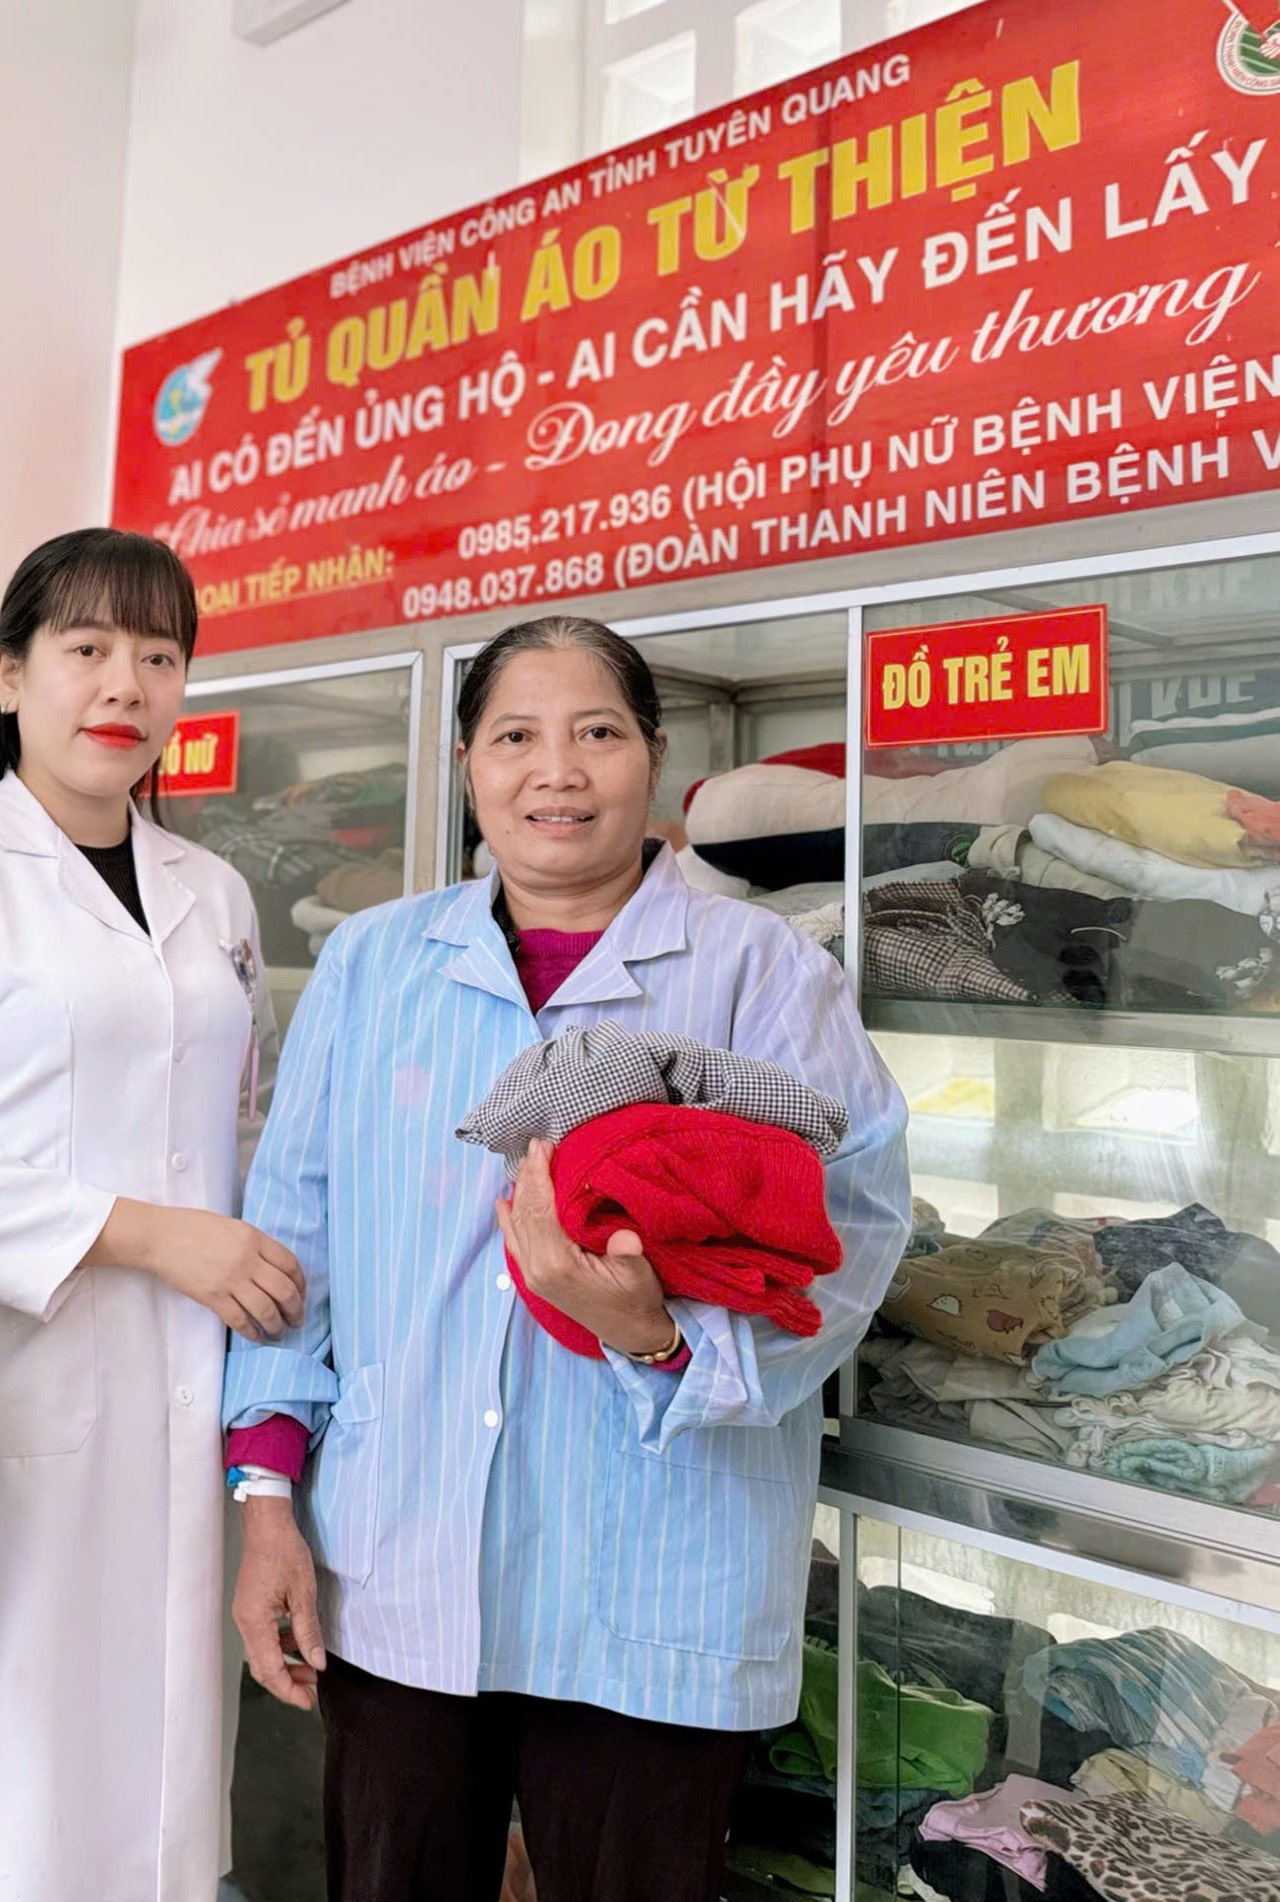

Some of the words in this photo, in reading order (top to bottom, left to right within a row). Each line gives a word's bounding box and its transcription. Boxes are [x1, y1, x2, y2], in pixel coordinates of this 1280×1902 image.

[244, 316, 311, 414] TỦ
[326, 260, 501, 388] QUẦN
[519, 225, 622, 322] ÁO
[646, 163, 761, 277] TỪ
[778, 59, 1082, 235] THIỆN
[329, 252, 395, 299] BỆNH
[398, 229, 456, 270] VIỆN
[460, 197, 536, 248] CÔNG
[542, 179, 582, 217] AN
[588, 149, 657, 198] TỈNH
[663, 106, 771, 170] TUYÊN
[781, 54, 911, 125] QUANG
[167, 460, 203, 506] AI
[208, 432, 261, 493] CÓ
[265, 405, 345, 477] ĐẾN
[354, 385, 445, 450] ỦNG
[458, 349, 527, 420] HỘ
[536, 370, 555, 386] -
[566, 331, 616, 389] AI
[631, 285, 748, 369] CẦN
[769, 247, 900, 333] HÃY
[920, 186, 1073, 290] ĐẾN
[1104, 129, 1268, 240] LẤY
[288, 454, 410, 531] manh
[414, 452, 476, 498] áo
[701, 354, 827, 440] đầy
[826, 330, 961, 427] yêu
[970, 262, 1263, 364] thương
[402, 551, 606, 619] 0948.037.868
[614, 522, 740, 586] (ĐOÀN
[751, 494, 907, 557] THANH
[925, 467, 1045, 529] NIÊN
[1066, 442, 1230, 506] BỆNH
[458, 483, 672, 560] 0985.217.936
[682, 456, 767, 523] (HỘI
[780, 440, 873, 496] PHỤ
[888, 414, 963, 474] NỮ
[972, 387, 1122, 458] BỆNH
[1142, 353, 1280, 421] VIỆN
[244, 557, 300, 607] TIẾP
[882, 645, 931, 710] ĐỒ
[942, 635, 1013, 705] TRẺ
[1027, 644, 1090, 698] EM
[184, 732, 219, 774] NỮ
